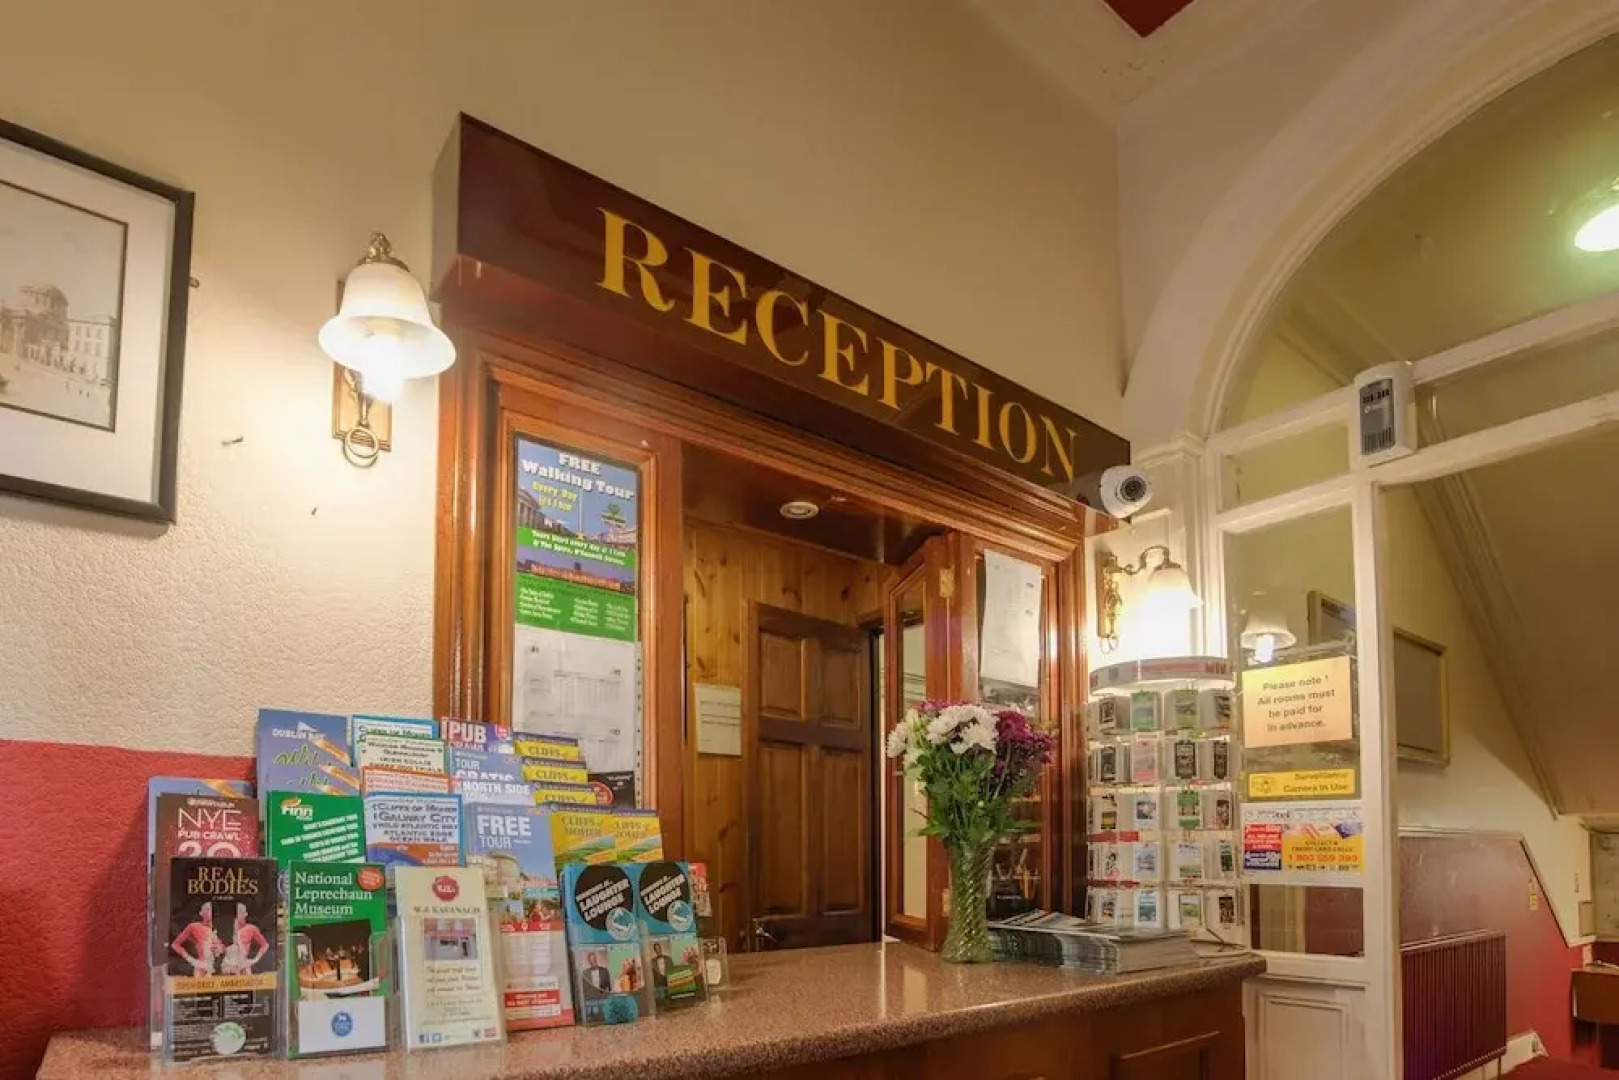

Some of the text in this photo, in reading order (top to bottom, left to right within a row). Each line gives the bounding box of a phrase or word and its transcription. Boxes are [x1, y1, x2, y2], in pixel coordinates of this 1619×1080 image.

[595, 207, 1078, 484] RECEPTION
[558, 452, 601, 476] FREE
[520, 458, 635, 500] Walking Tour
[1262, 681, 1296, 691] Please
[1298, 677, 1322, 687] note
[1257, 689, 1335, 706] All rooms must
[1268, 704, 1323, 718] be paid for
[450, 720, 486, 743] PUB
[1267, 719, 1327, 732] in advance.
[454, 757, 480, 771] TOUR
[1294, 771, 1349, 781] Surveillance
[462, 781, 531, 796] NORTH SIDE
[1283, 784, 1319, 793] Camera
[1331, 783, 1349, 792] Use
[177, 807, 241, 831] NYE
[477, 814, 532, 837] FREE
[177, 828, 241, 842] PUB CRAWL
[479, 834, 511, 850] TOUR
[198, 866, 247, 882] REAL
[295, 871, 352, 885] National
[187, 879, 259, 895] BODIES
[295, 886, 373, 903] Leprechaun
[294, 902, 354, 916] Museum
